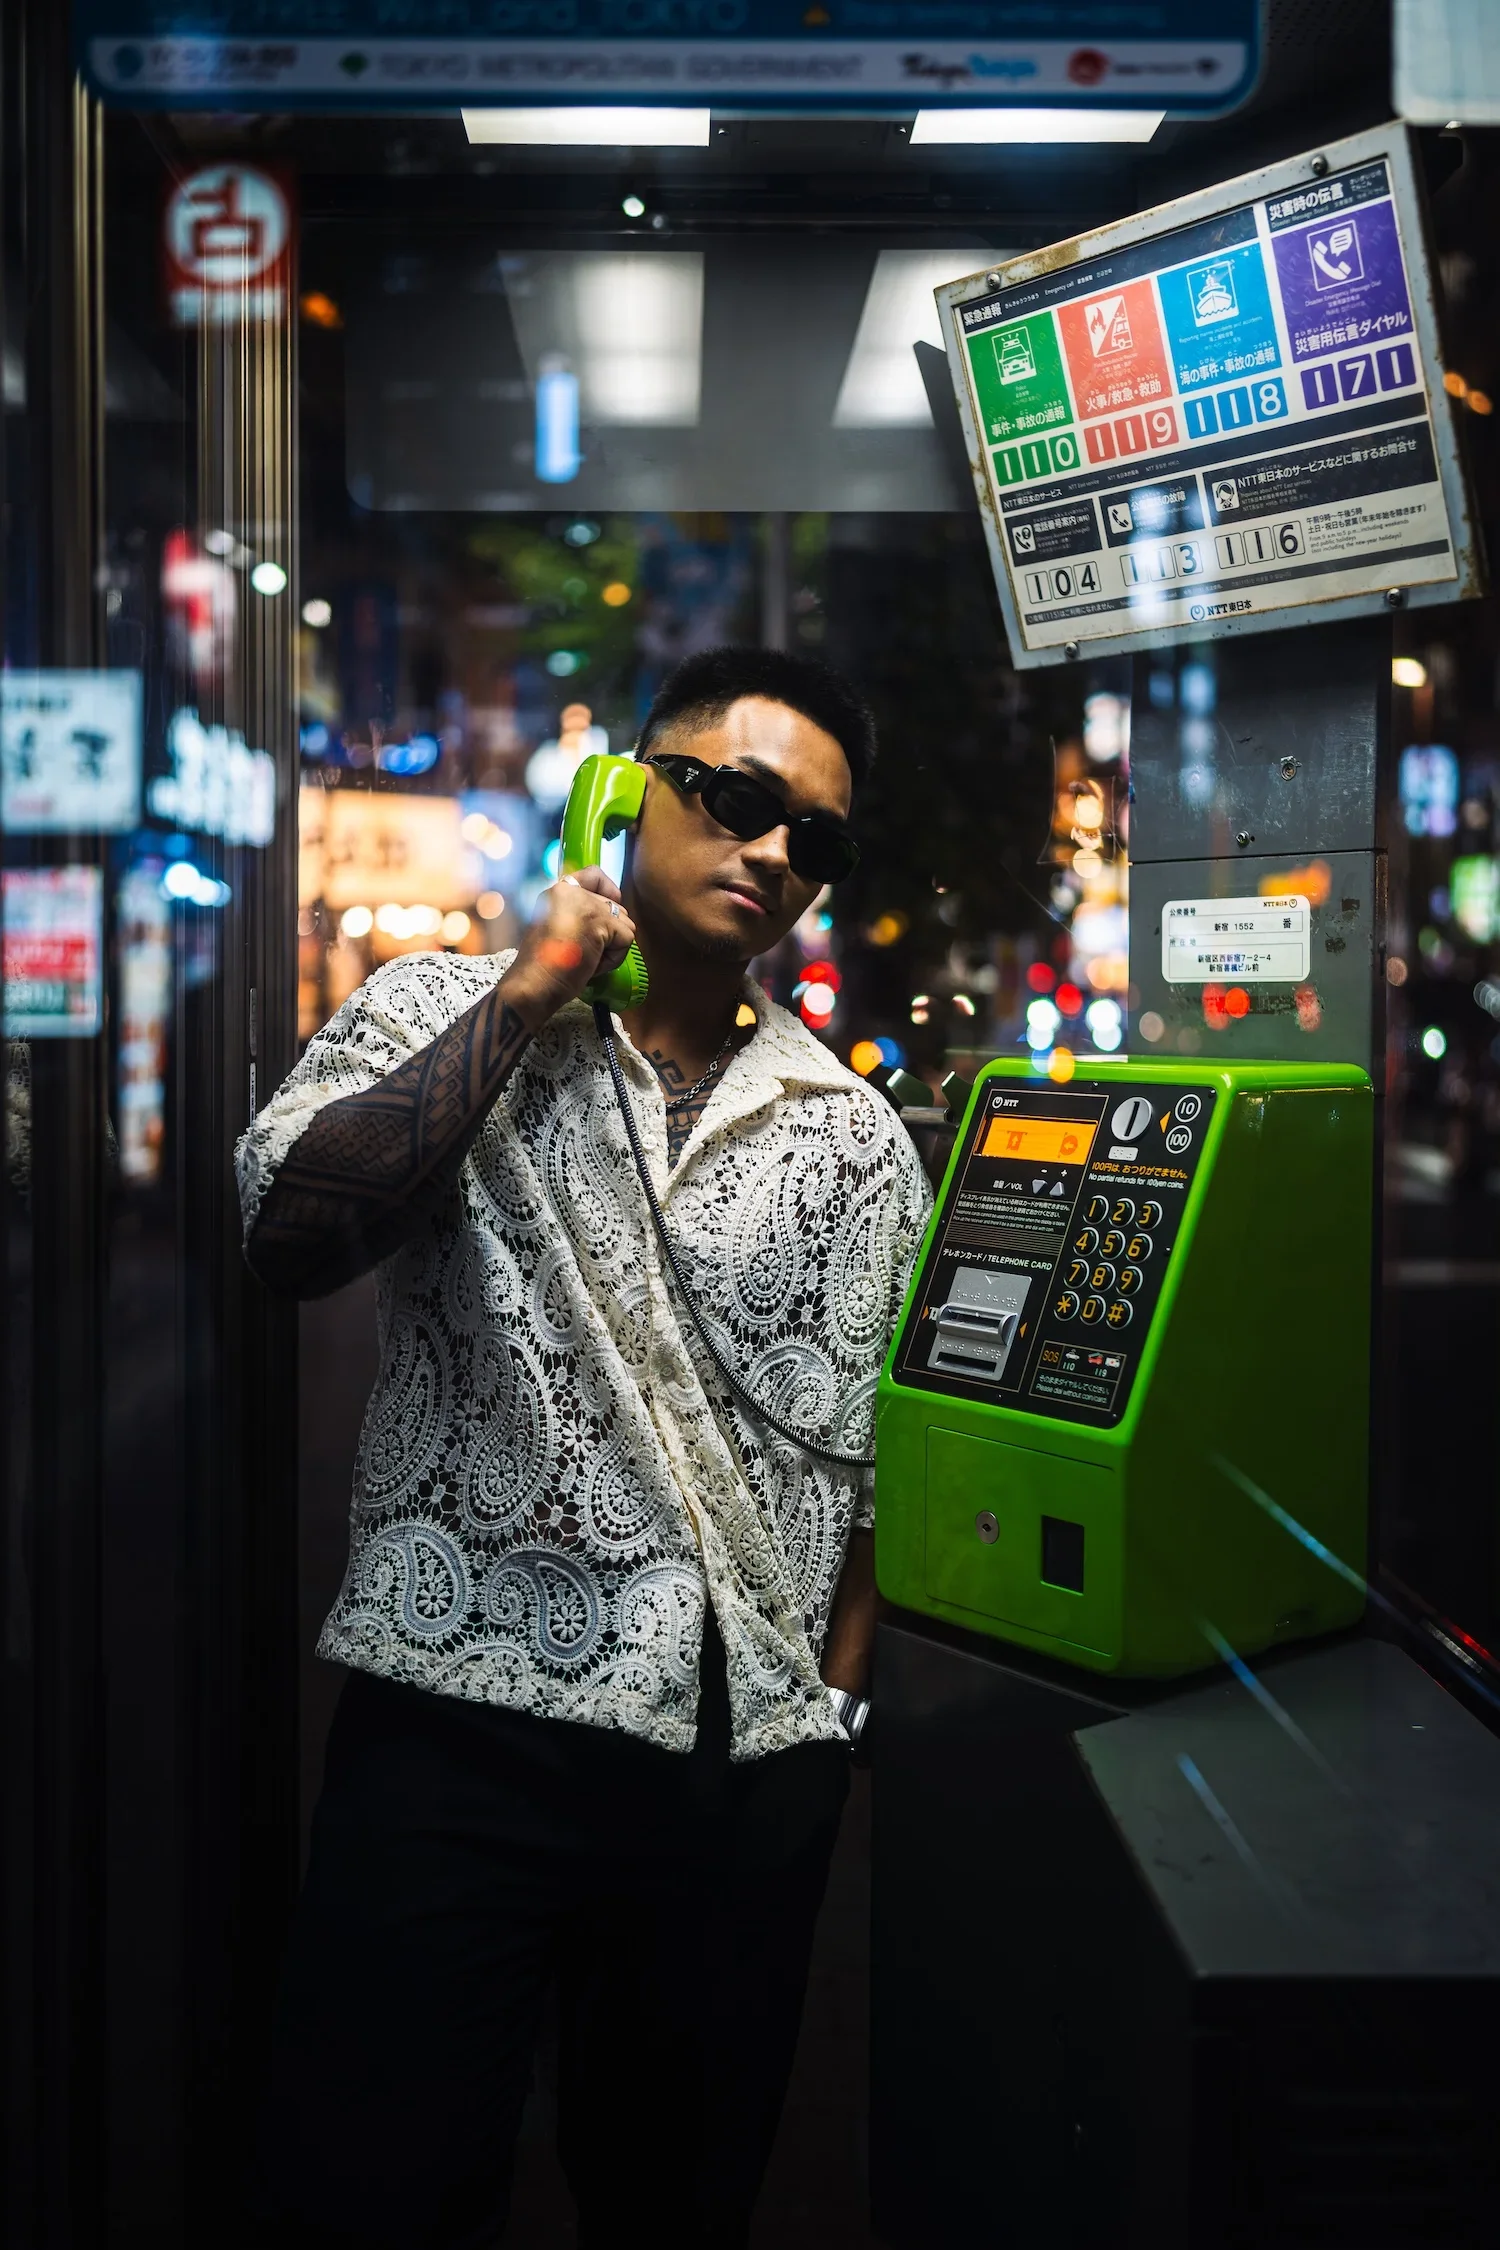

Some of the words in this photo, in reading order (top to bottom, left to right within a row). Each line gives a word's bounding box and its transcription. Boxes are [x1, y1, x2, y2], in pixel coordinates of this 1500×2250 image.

[1269, 182, 1344, 221] 災害時の伝言
[963, 302, 1002, 326] 緊急通報
[1295, 311, 1408, 355] 災害用伝言ダイヤル
[1180, 346, 1276, 386] 海の事件・事故の通報
[1314, 351, 1402, 403] 171
[1196, 383, 1281, 432] 118
[990, 405, 1066, 437] 事件・事故の通報
[1095, 411, 1172, 458] 119
[1003, 437, 1075, 480] 110
[1237, 438, 1418, 489] NTT東日本のサービスなどに関するお問合せ
[1003, 488, 1063, 509] NTT東日本のサービス
[1225, 524, 1299, 566] 116
[1335, 535, 1356, 545] holidays
[1130, 545, 1198, 583] 113
[1034, 564, 1096, 601] 104
[1206, 599, 1252, 616] NTT東日本
[1170, 907, 1196, 916] 公衆番号
[1214, 923, 1229, 932] 新宿
[1234, 922, 1254, 931] 1552
[1283, 917, 1292, 929] 番
[1003, 1099, 1019, 1107] NTT
[1180, 1101, 1195, 1115] 10
[1169, 1133, 1188, 1147] 100
[1088, 1172, 1097, 1180] No
[1097, 1174, 1115, 1182] partial
[1115, 1176, 1137, 1185] refunds
[1146, 1178, 1167, 1188] 100yen
[1088, 1200, 1096, 1217] 1
[1112, 1202, 1125, 1221] 2
[1138, 1205, 1151, 1224] 3
[1076, 1232, 1089, 1250] 4
[1102, 1234, 1116, 1253] 5
[1127, 1238, 1143, 1257] 6
[943, 1248, 983, 1261] テレホンカード
[987, 1254, 1029, 1268] TELEPHONE
[1030, 1260, 1053, 1271] CARD
[1070, 1264, 1081, 1282] 7
[1092, 1267, 1106, 1286] 8
[1121, 1270, 1133, 1290] 9
[1082, 1299, 1096, 1318] 0
[1042, 1350, 1060, 1363] SOS
[1062, 1361, 1076, 1371] 110
[1094, 1367, 1108, 1378] 119
[1036, 1383, 1054, 1393] Please
[1053, 1386, 1063, 1394] dial
